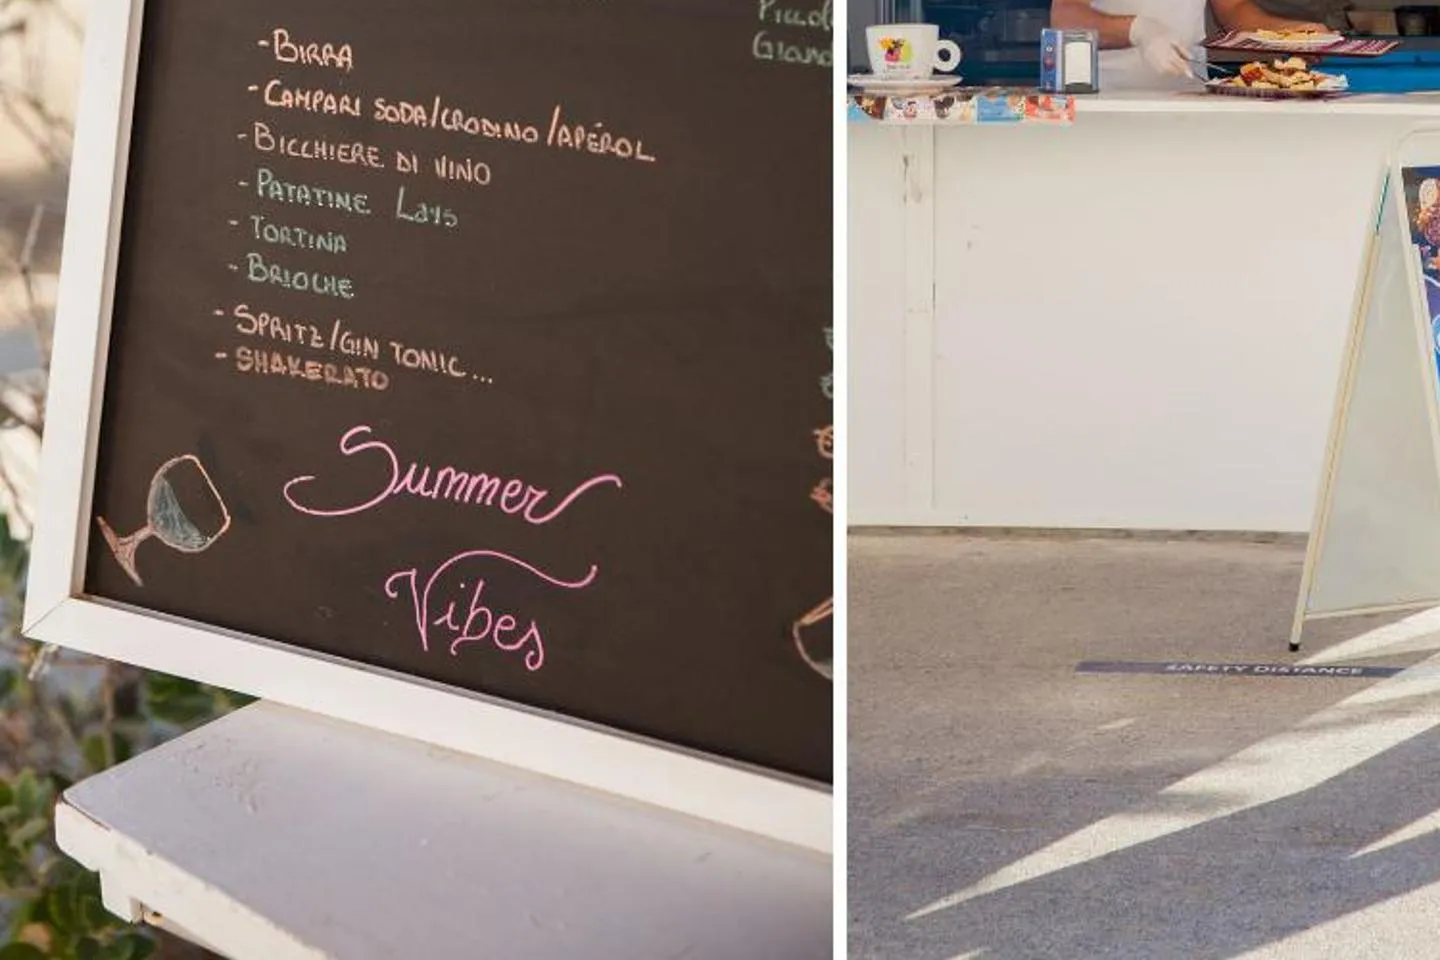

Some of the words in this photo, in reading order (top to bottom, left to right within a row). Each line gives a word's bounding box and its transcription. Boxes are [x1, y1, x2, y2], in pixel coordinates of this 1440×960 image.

[397, 151, 419, 175] DI
[435, 155, 492, 185] VINO
[235, 346, 390, 390] SHAKERATO
[284, 425, 622, 524] Summer
[385, 550, 597, 670] Vibes
[1165, 664, 1247, 673] SAFETY
[1254, 665, 1363, 675] DISTANCE
